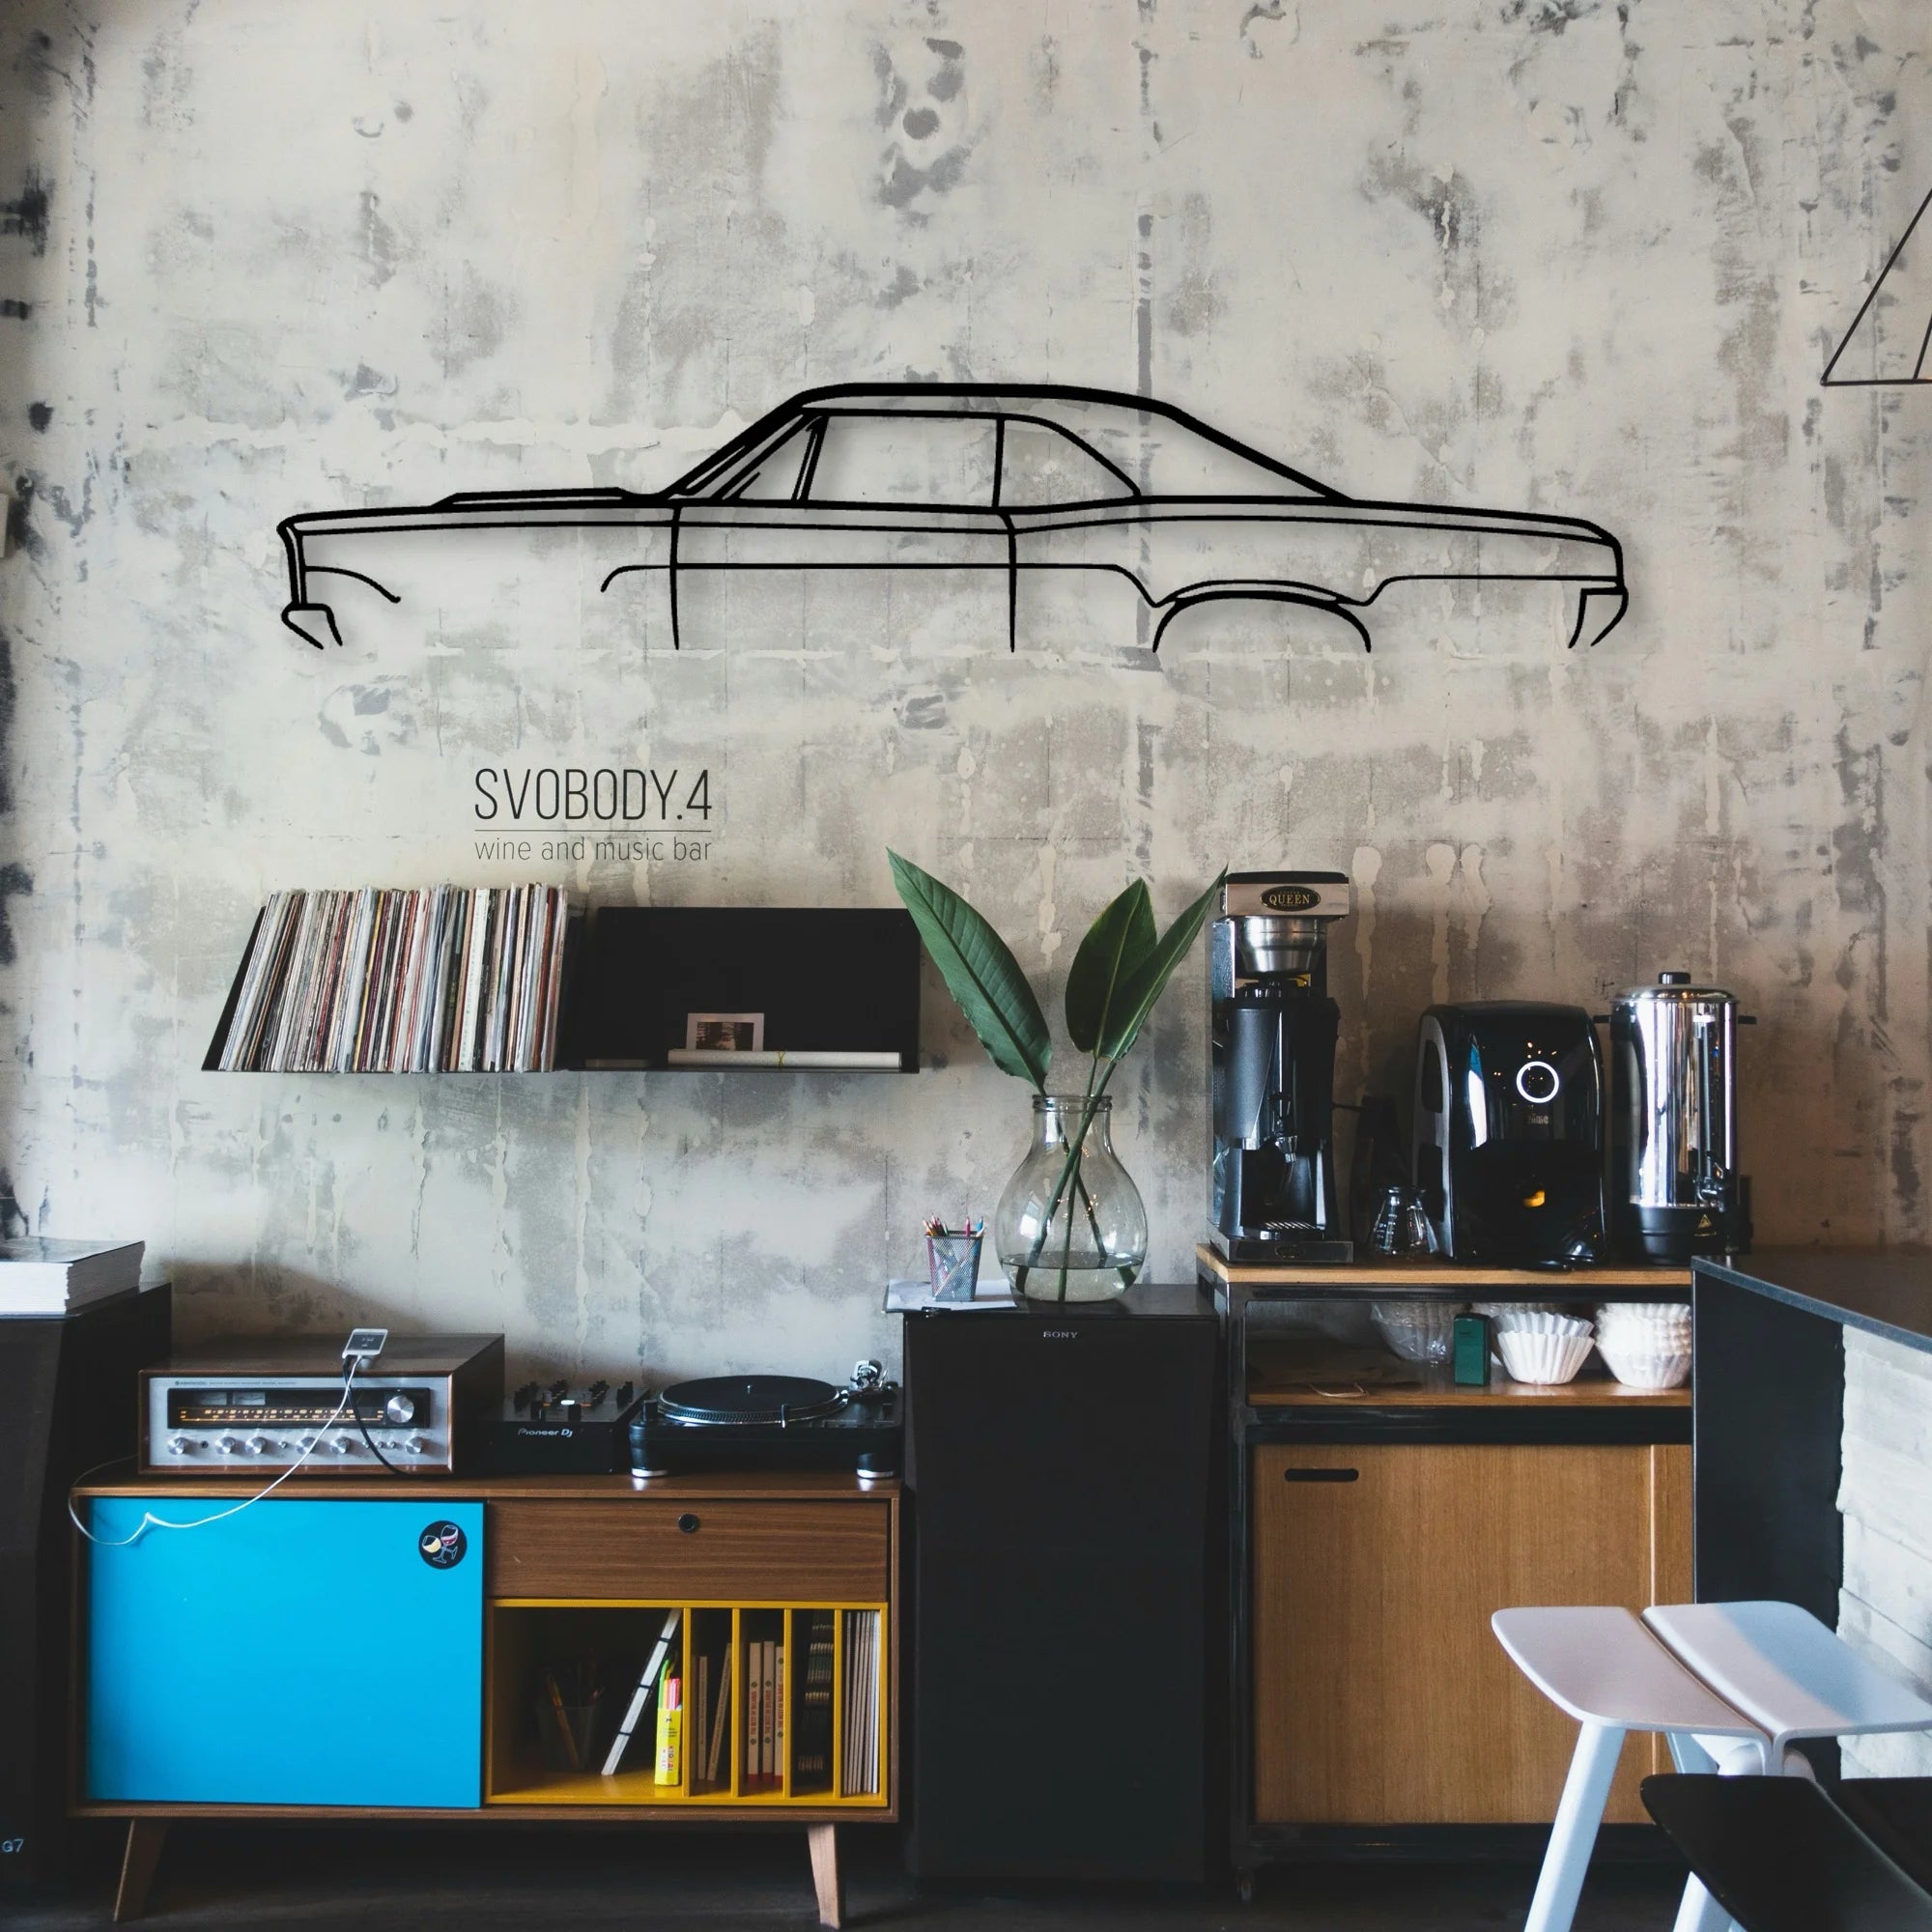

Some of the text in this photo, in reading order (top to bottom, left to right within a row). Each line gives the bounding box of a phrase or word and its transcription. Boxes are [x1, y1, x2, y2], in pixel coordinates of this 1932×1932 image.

[474, 768, 713, 820] SVOBODY.4
[474, 836, 713, 861] wine and music bar
[1269, 895, 1310, 905] QUEEN
[2, 1838, 24, 1853] G7
